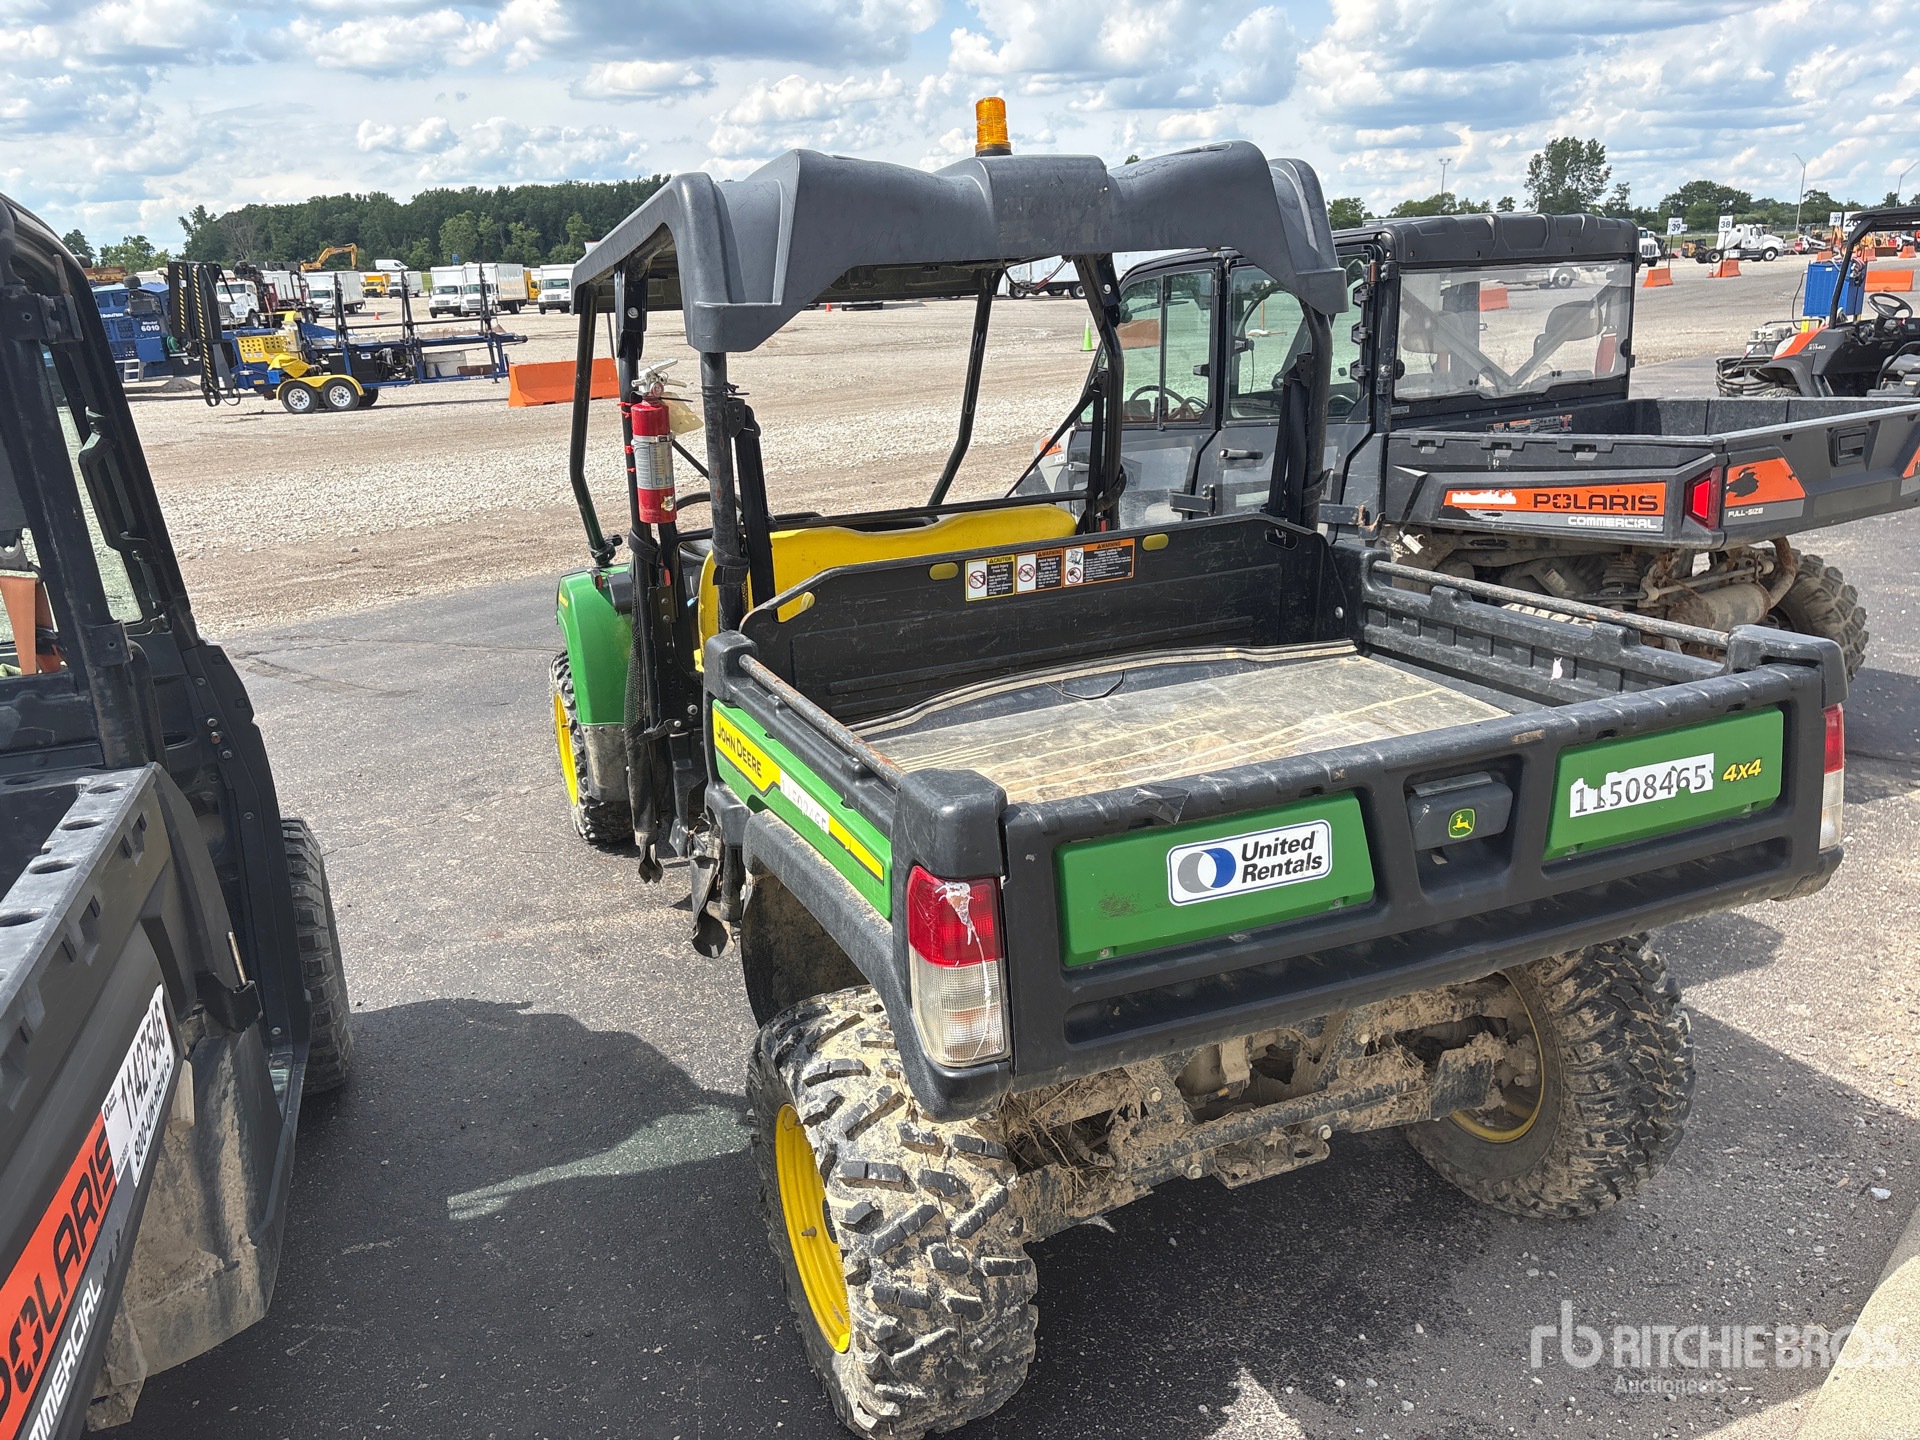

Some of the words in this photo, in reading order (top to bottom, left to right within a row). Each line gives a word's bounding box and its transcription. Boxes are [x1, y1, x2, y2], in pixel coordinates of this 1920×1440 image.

[1671, 223, 1681, 232] 39
[1720, 220, 1731, 229] 38
[1533, 493, 1658, 511] POLARIS
[1727, 507, 1764, 518] FULL-SIZE
[1567, 515, 1658, 529] COMMERCIAL
[1041, 549, 1062, 557] WARNING
[1102, 541, 1121, 549] WARNING
[717, 721, 736, 753] JOHN
[736, 738, 762, 778] DEERE
[1575, 764, 1707, 813] 11508465
[1241, 831, 1316, 862] United
[1241, 853, 1323, 884] Rentals
[121, 1000, 166, 1130] 11427546
